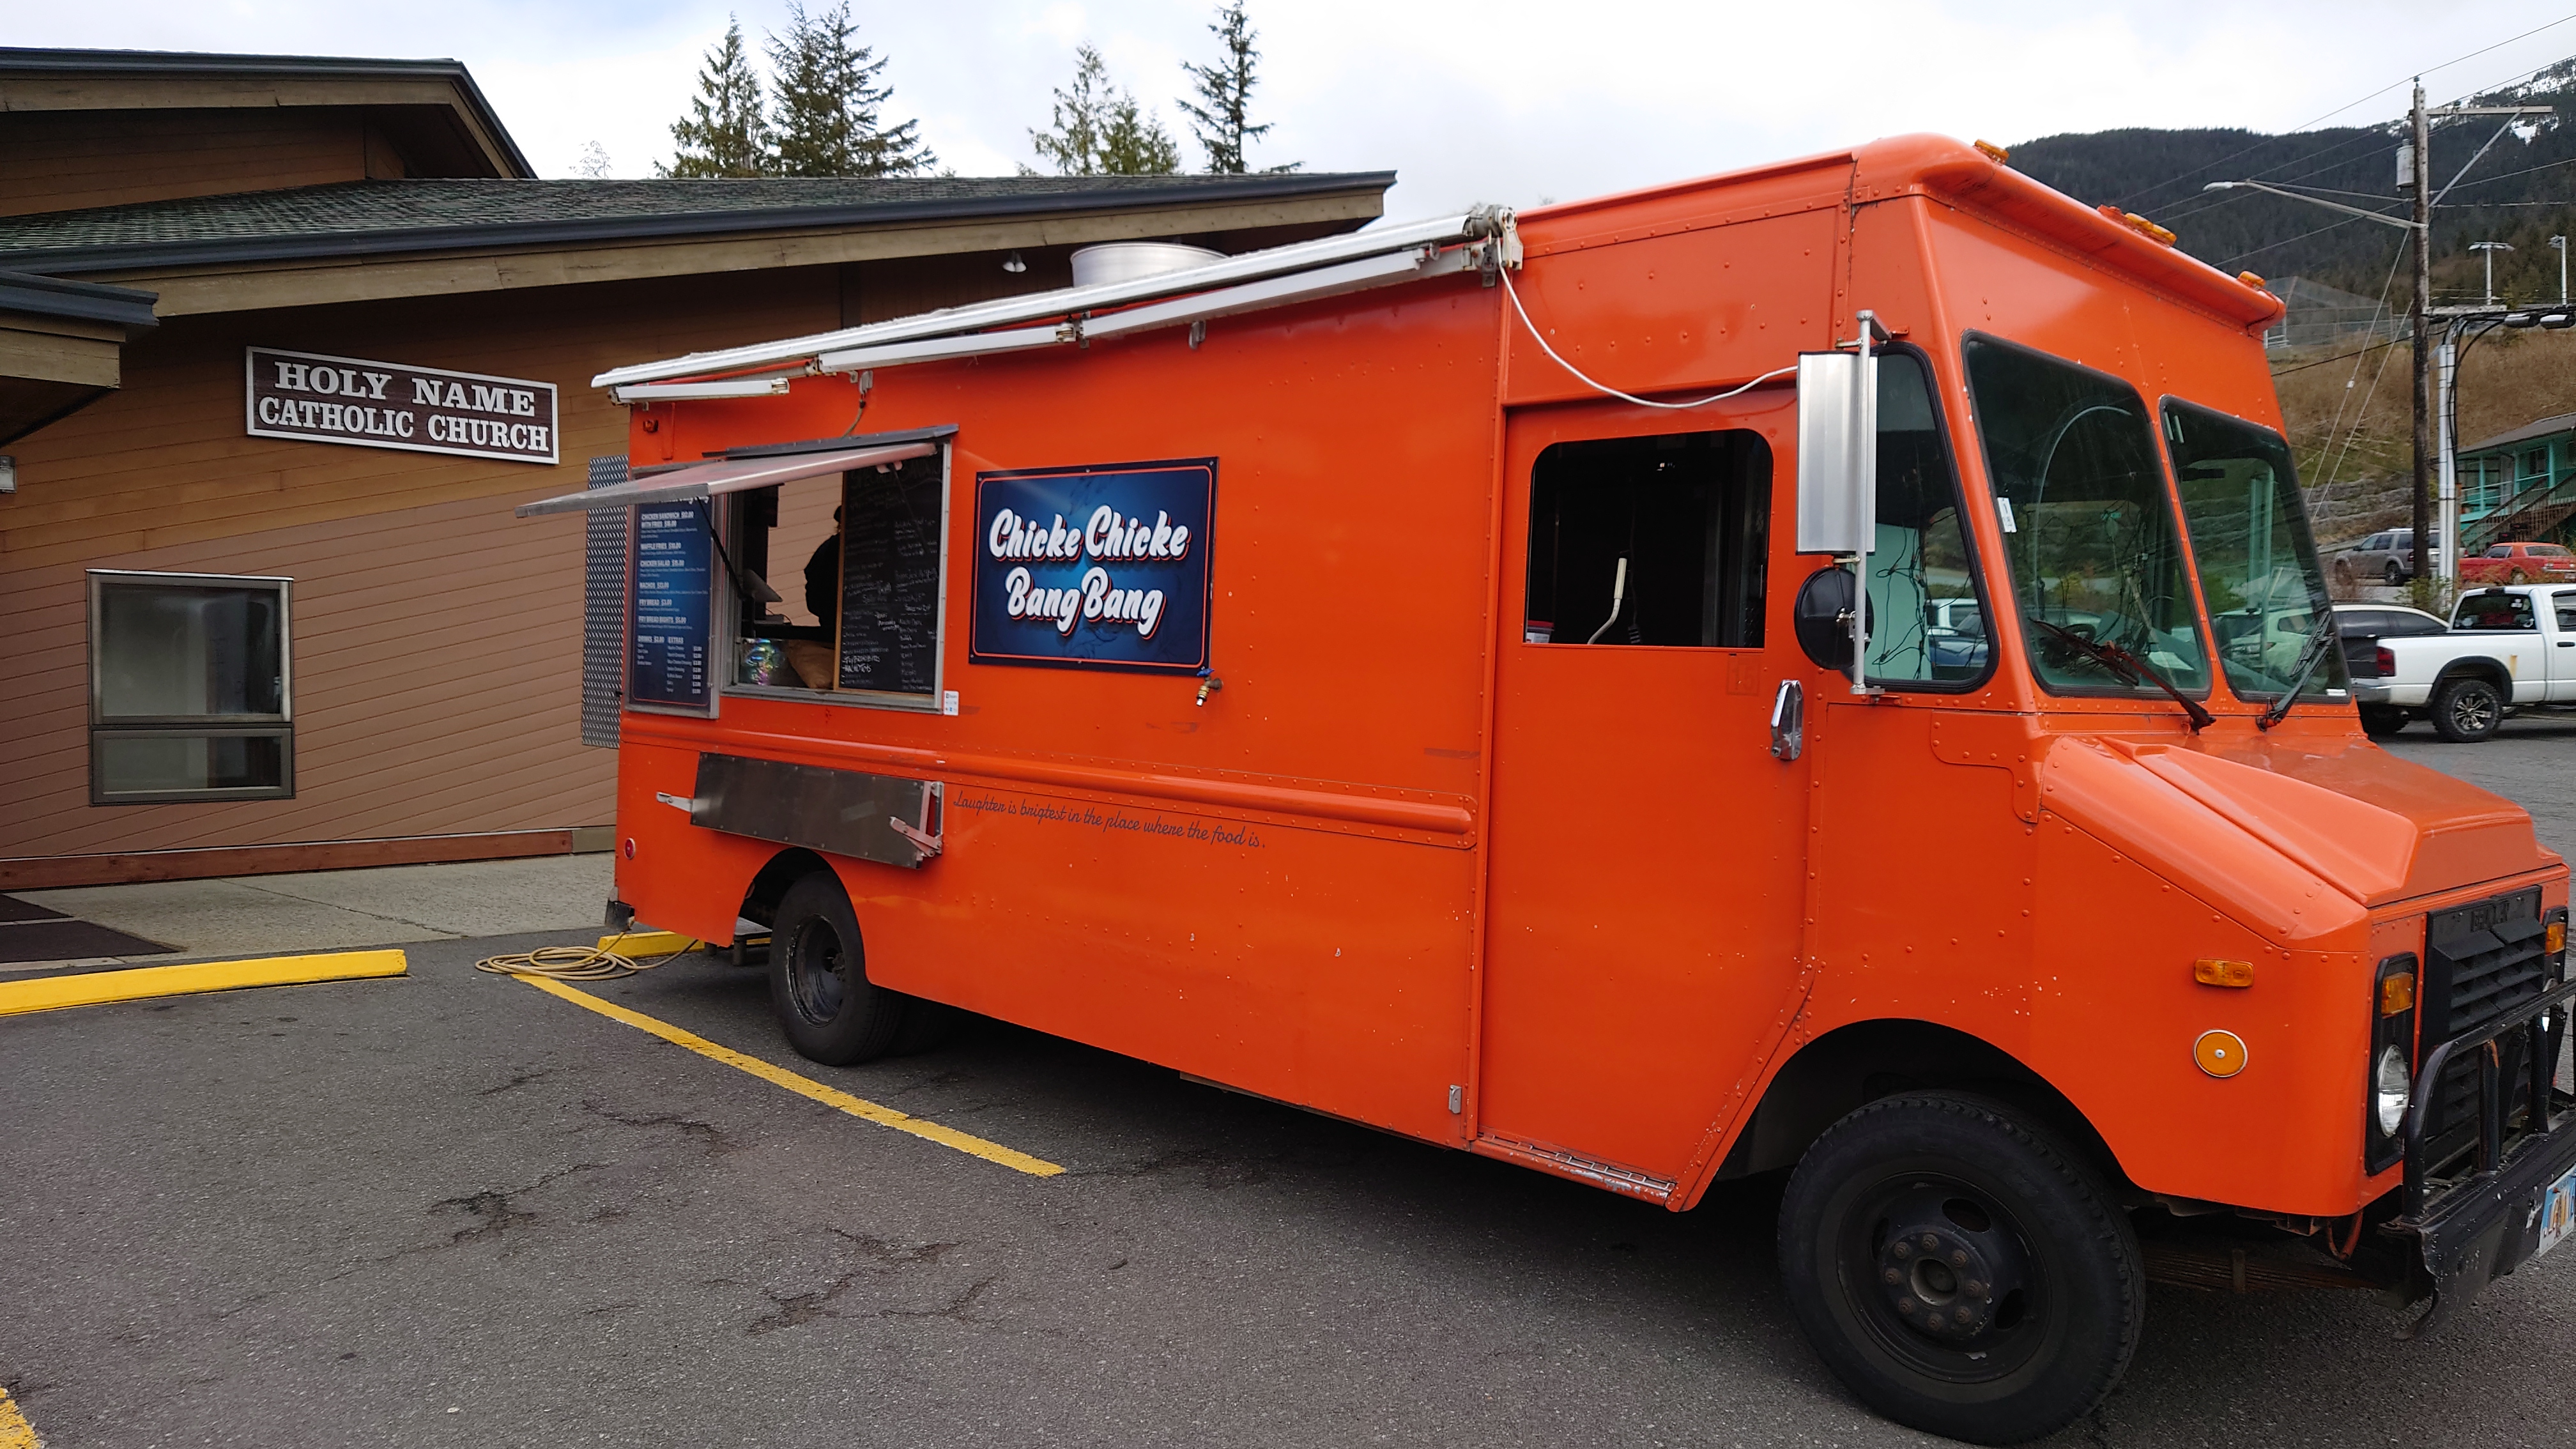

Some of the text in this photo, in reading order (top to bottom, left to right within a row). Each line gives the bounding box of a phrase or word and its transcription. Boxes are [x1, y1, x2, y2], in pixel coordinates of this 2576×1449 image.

[275, 362, 534, 417] HOLY NAME
[259, 397, 549, 452] CATHOLIC CHURCH
[989, 508, 1084, 562] Chicke
[1085, 503, 1192, 561] Chicke
[1005, 566, 1166, 639] Bang Bang
[953, 790, 1006, 817] Laughter
[1008, 800, 1016, 815] is
[1068, 808, 1081, 823] in
[1084, 806, 1103, 826] the
[1103, 810, 1140, 832] place
[1144, 816, 1184, 838] where
[1187, 818, 1209, 840] the
[1211, 825, 1246, 847] food
[1248, 831, 1266, 849] is.
